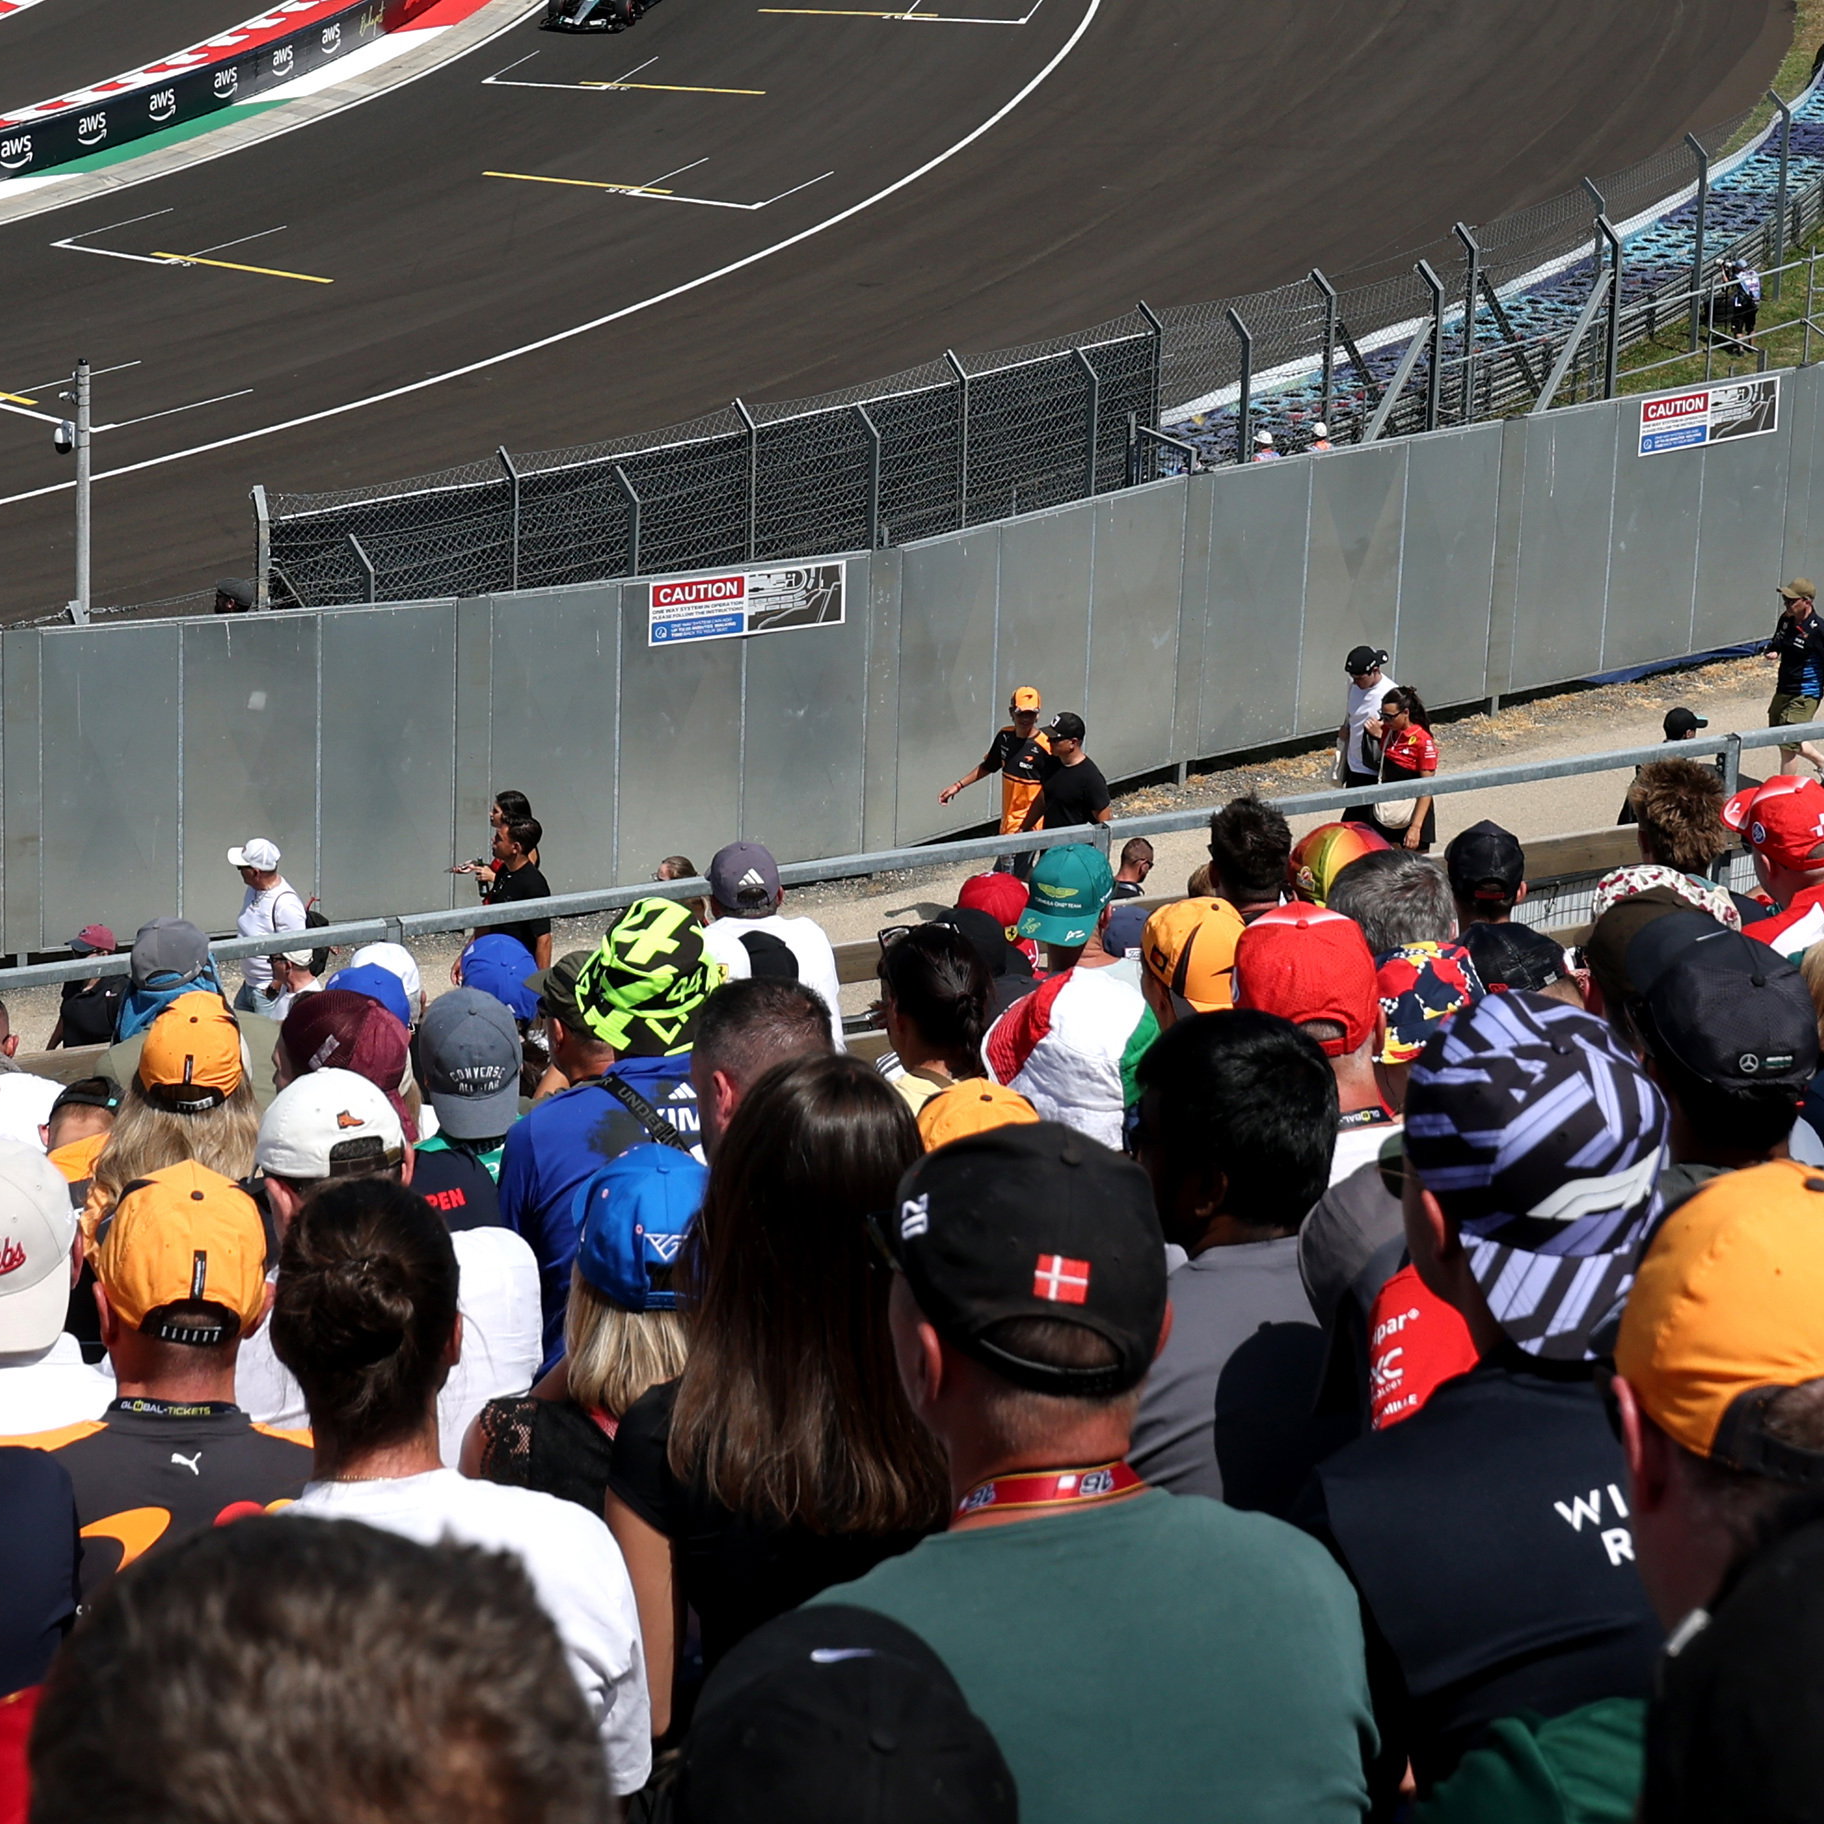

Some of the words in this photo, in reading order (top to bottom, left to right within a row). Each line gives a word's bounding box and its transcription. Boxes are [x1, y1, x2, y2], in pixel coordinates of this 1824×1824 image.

[214, 67, 237, 91] aws
[1648, 397, 1704, 418] CAUTION
[659, 581, 738, 603] CAUTION
[449, 1066, 506, 1083] CONVERSE
